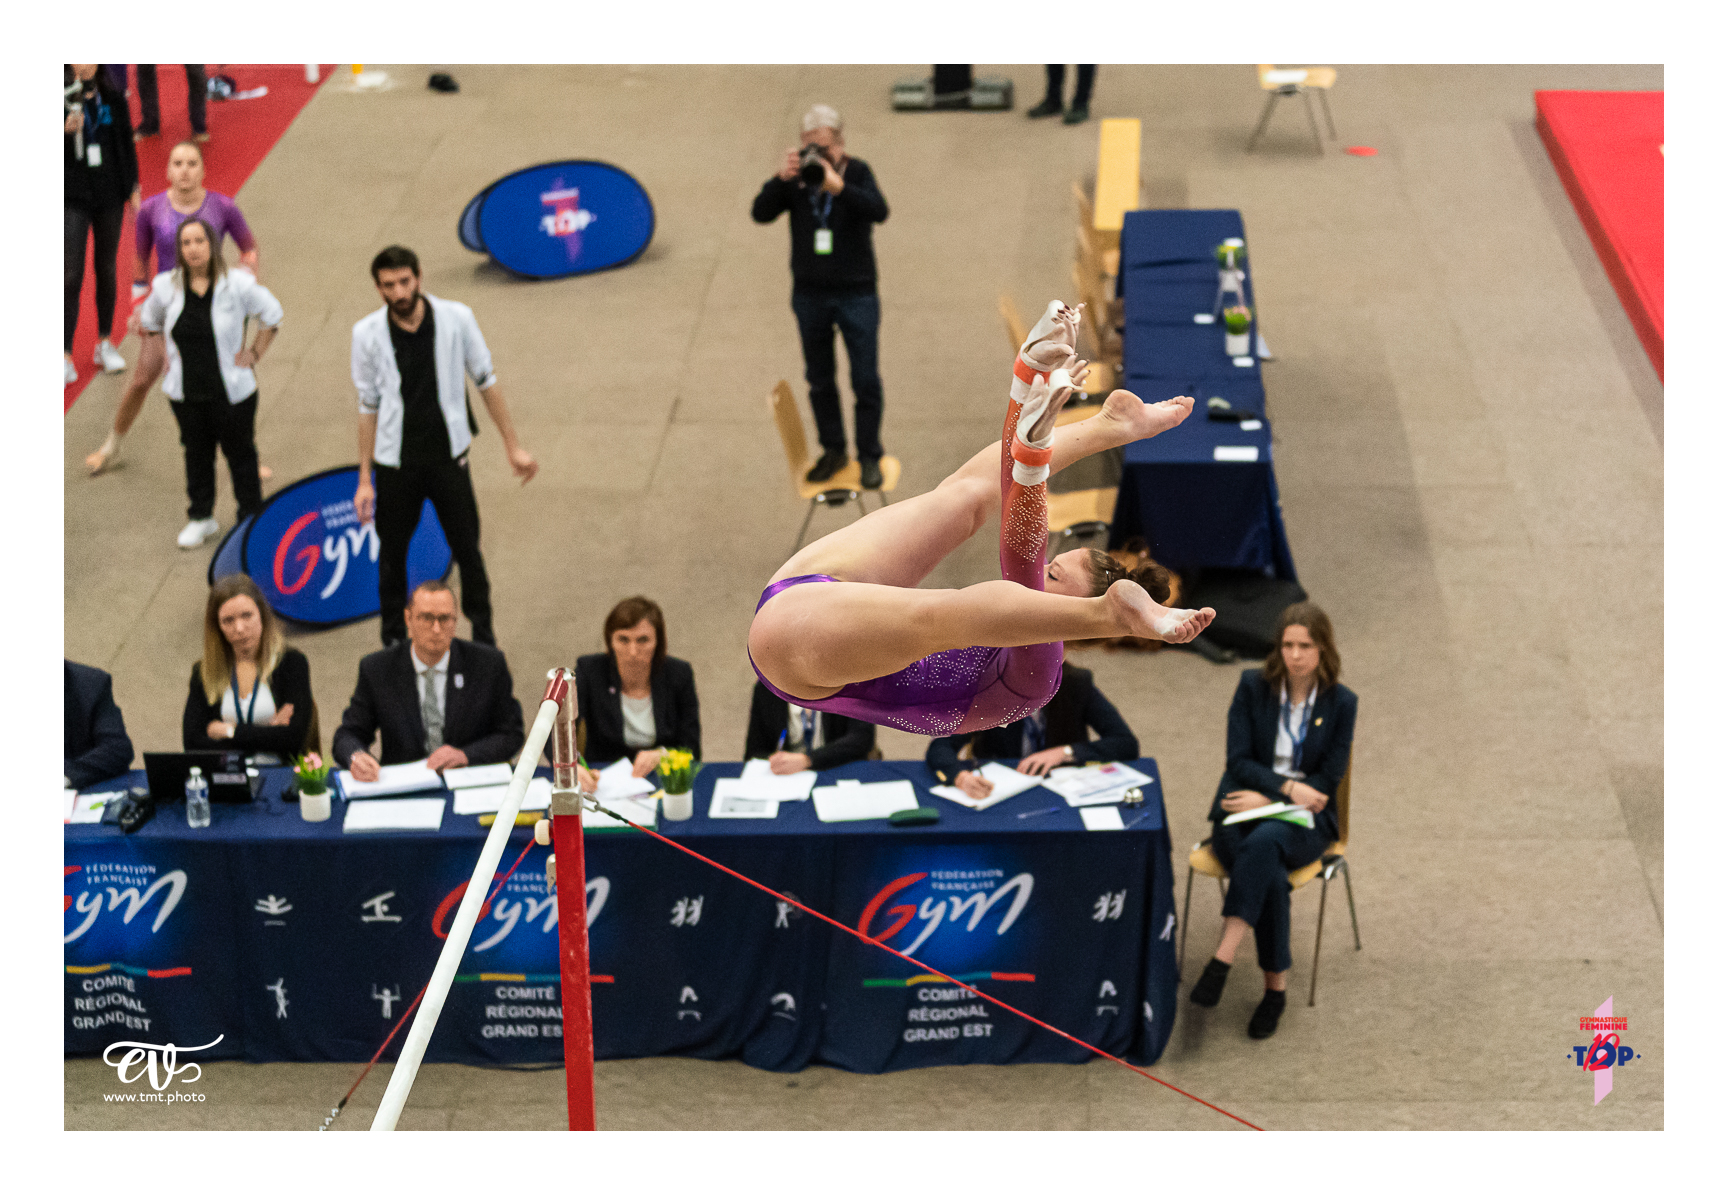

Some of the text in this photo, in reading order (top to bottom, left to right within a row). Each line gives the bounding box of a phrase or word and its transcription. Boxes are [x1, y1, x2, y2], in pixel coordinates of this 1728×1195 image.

[858, 872, 1034, 957] Gym
[74, 992, 146, 1012] RÉGIONAL
[908, 1004, 989, 1022] RÉGIONAL
[481, 1025, 563, 1038] GRAND ES
[903, 1023, 993, 1042] GRAND EST
